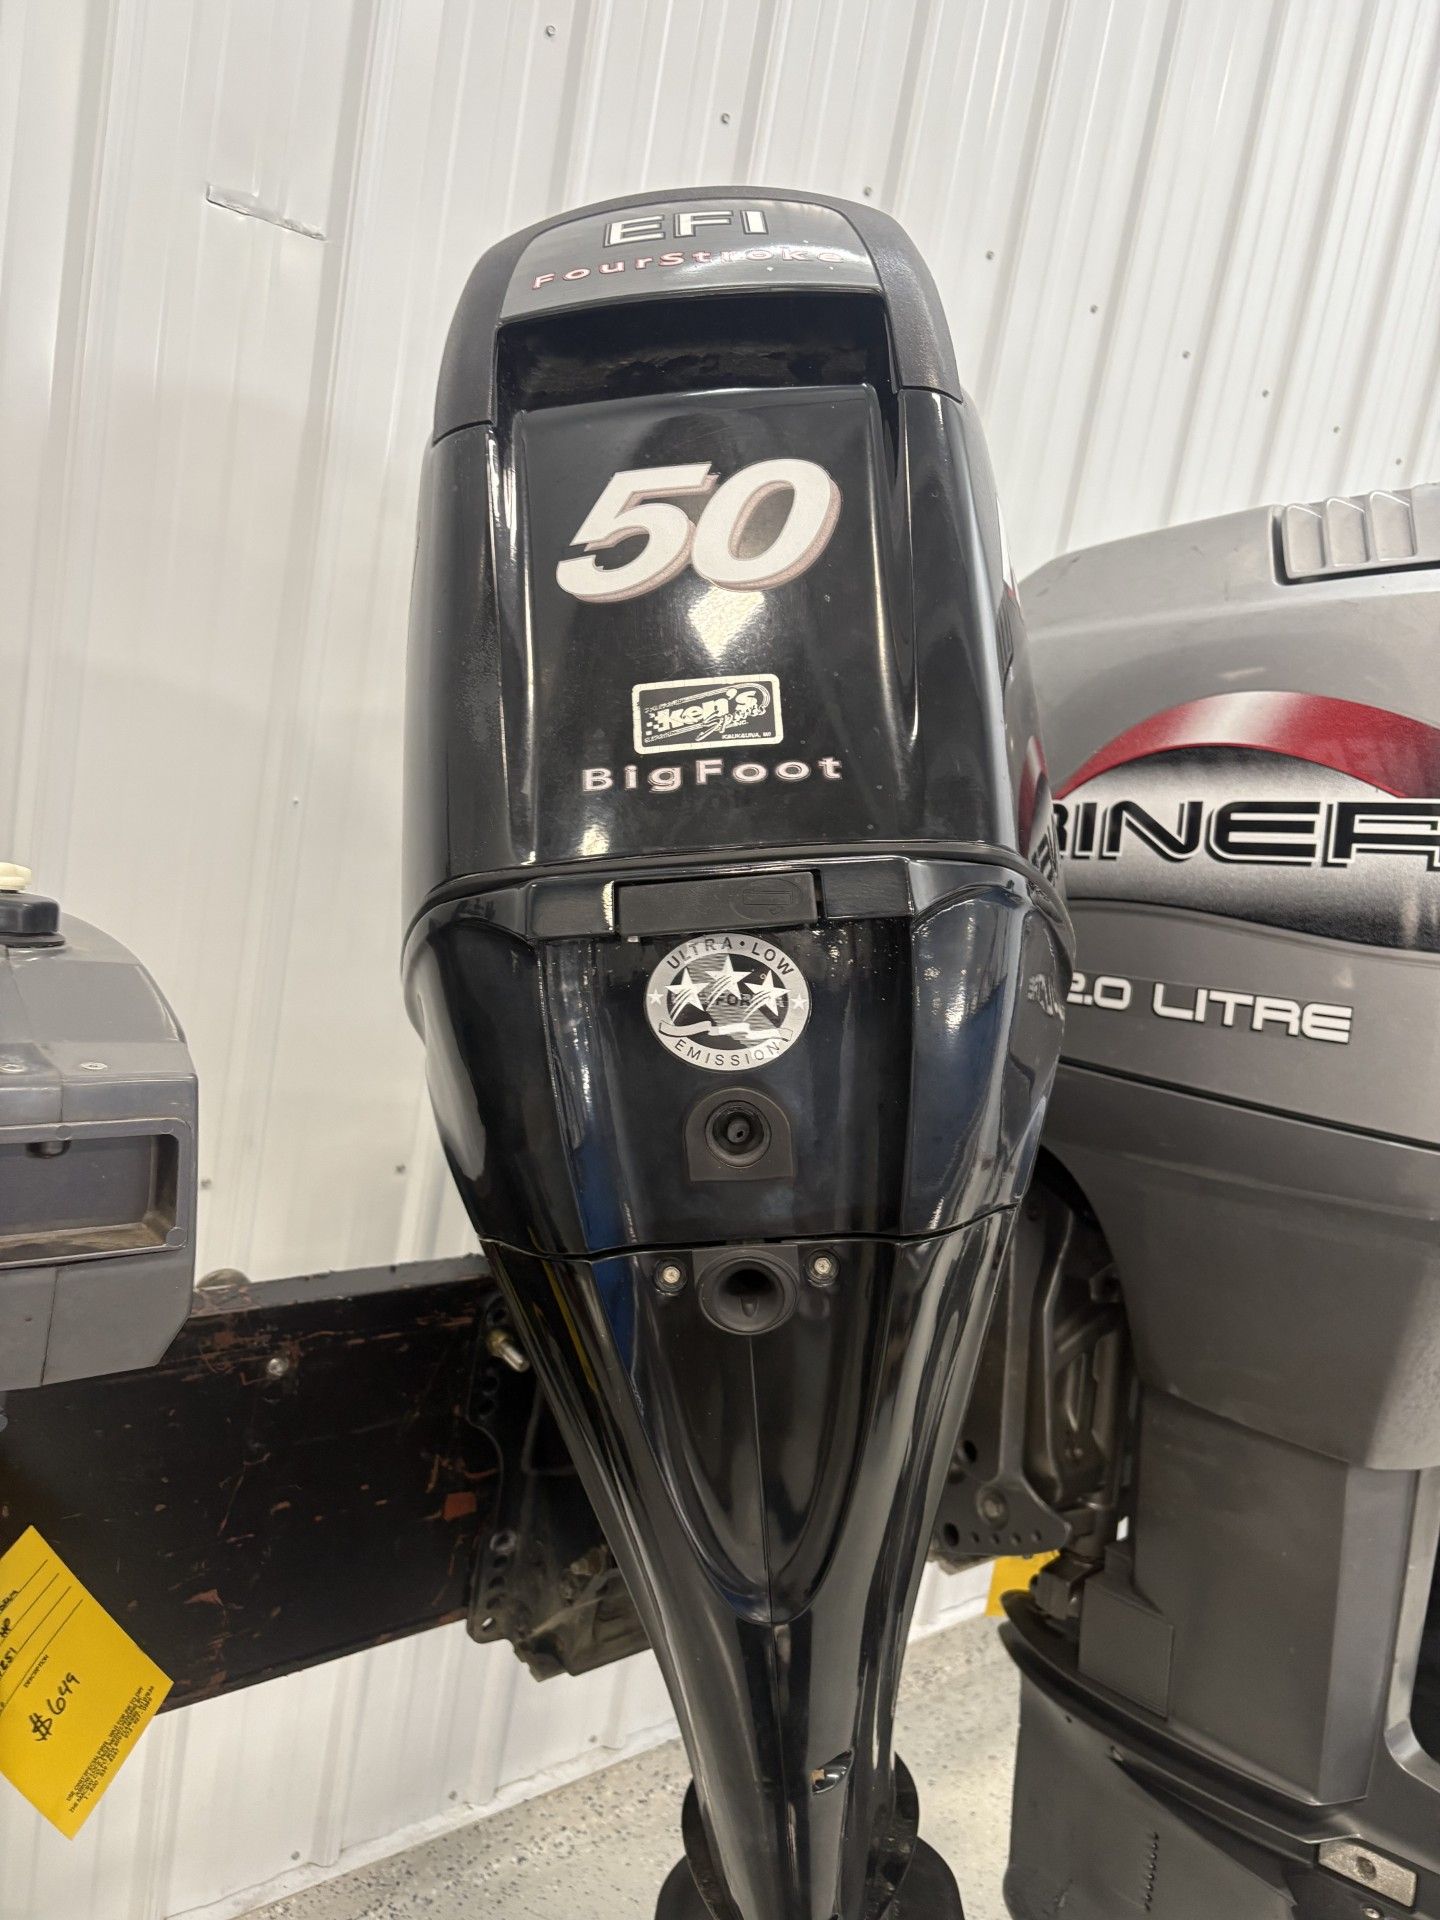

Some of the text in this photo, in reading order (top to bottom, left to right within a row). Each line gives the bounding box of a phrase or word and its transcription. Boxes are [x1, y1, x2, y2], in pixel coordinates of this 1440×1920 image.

[603, 209, 769, 248] EFI
[531, 247, 845, 291] FourStroke
[555, 458, 843, 604] 50
[581, 755, 844, 794] BigFoot
[1052, 801, 1440, 872] INER
[666, 937, 795, 976] ULTRA LOW
[1153, 982, 1354, 1045] LITRE
[674, 1038, 781, 1067] EMISSION
